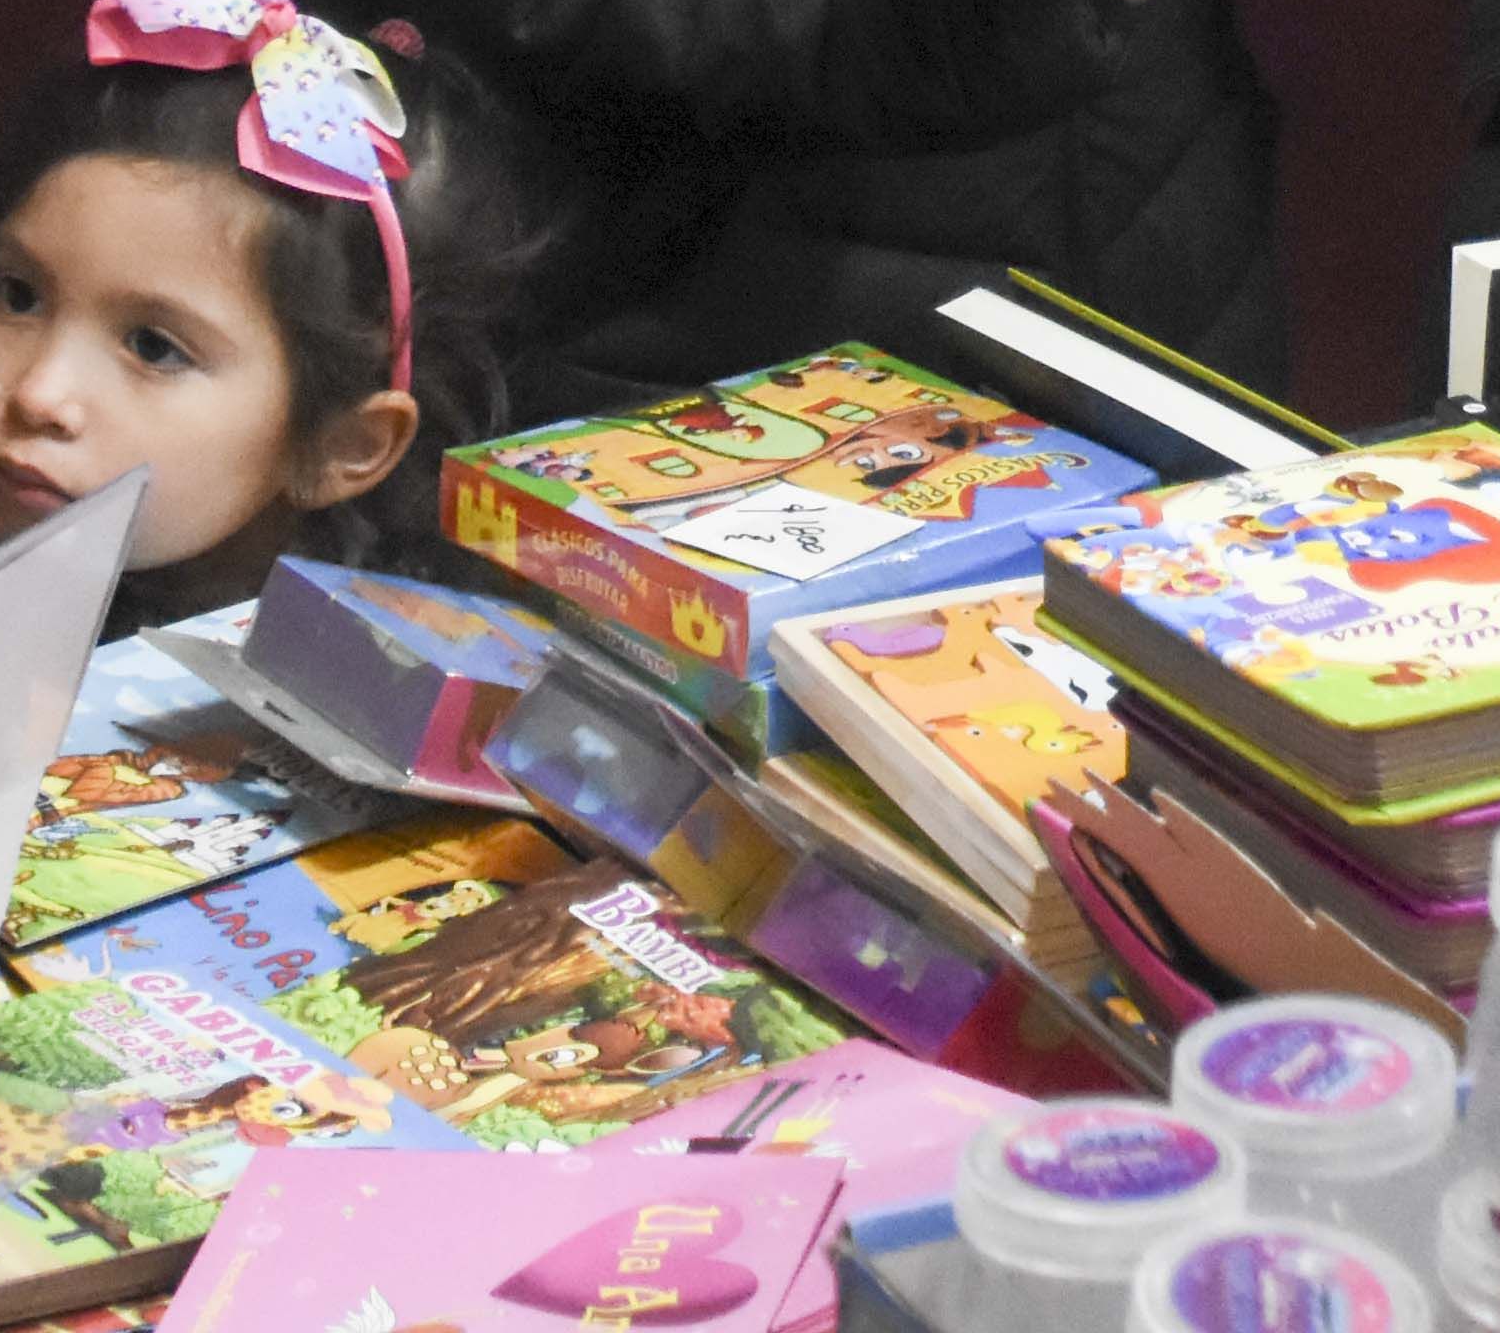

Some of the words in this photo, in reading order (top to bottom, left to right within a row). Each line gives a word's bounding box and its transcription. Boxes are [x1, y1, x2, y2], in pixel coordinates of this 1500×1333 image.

[1321, 601, 1490, 645] Botas
[188, 882, 272, 950] Lino
[578, 883, 722, 992] BAMBI
[75, 1008, 199, 1088] ELEGANTE
[131, 974, 315, 1085] GABINA
